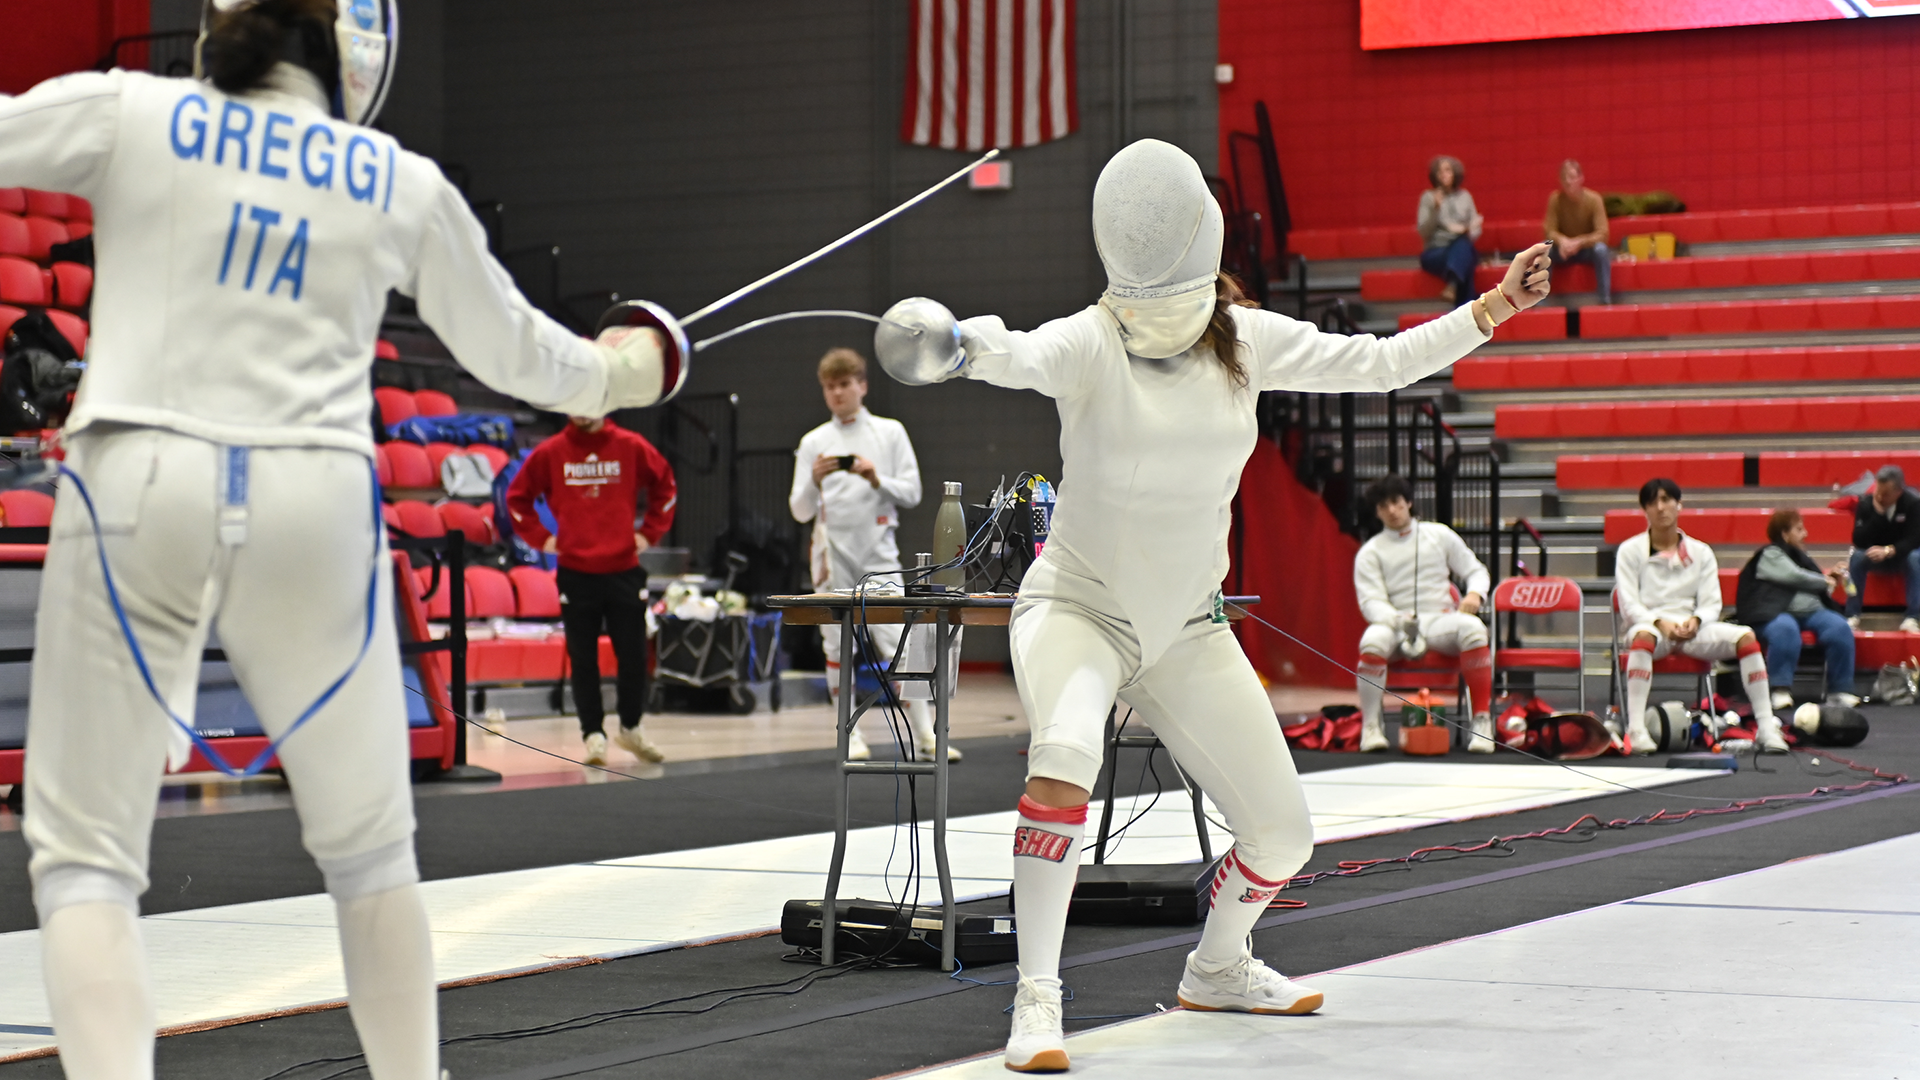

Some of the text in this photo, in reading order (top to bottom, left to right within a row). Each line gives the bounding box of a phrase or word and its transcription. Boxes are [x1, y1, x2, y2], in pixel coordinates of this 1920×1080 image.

[169, 93, 395, 213] GREGGI
[218, 202, 309, 301] ITA
[564, 461, 620, 477] PIONEERS
[1510, 582, 1565, 608] SHU
[1013, 826, 1074, 863] SHU
